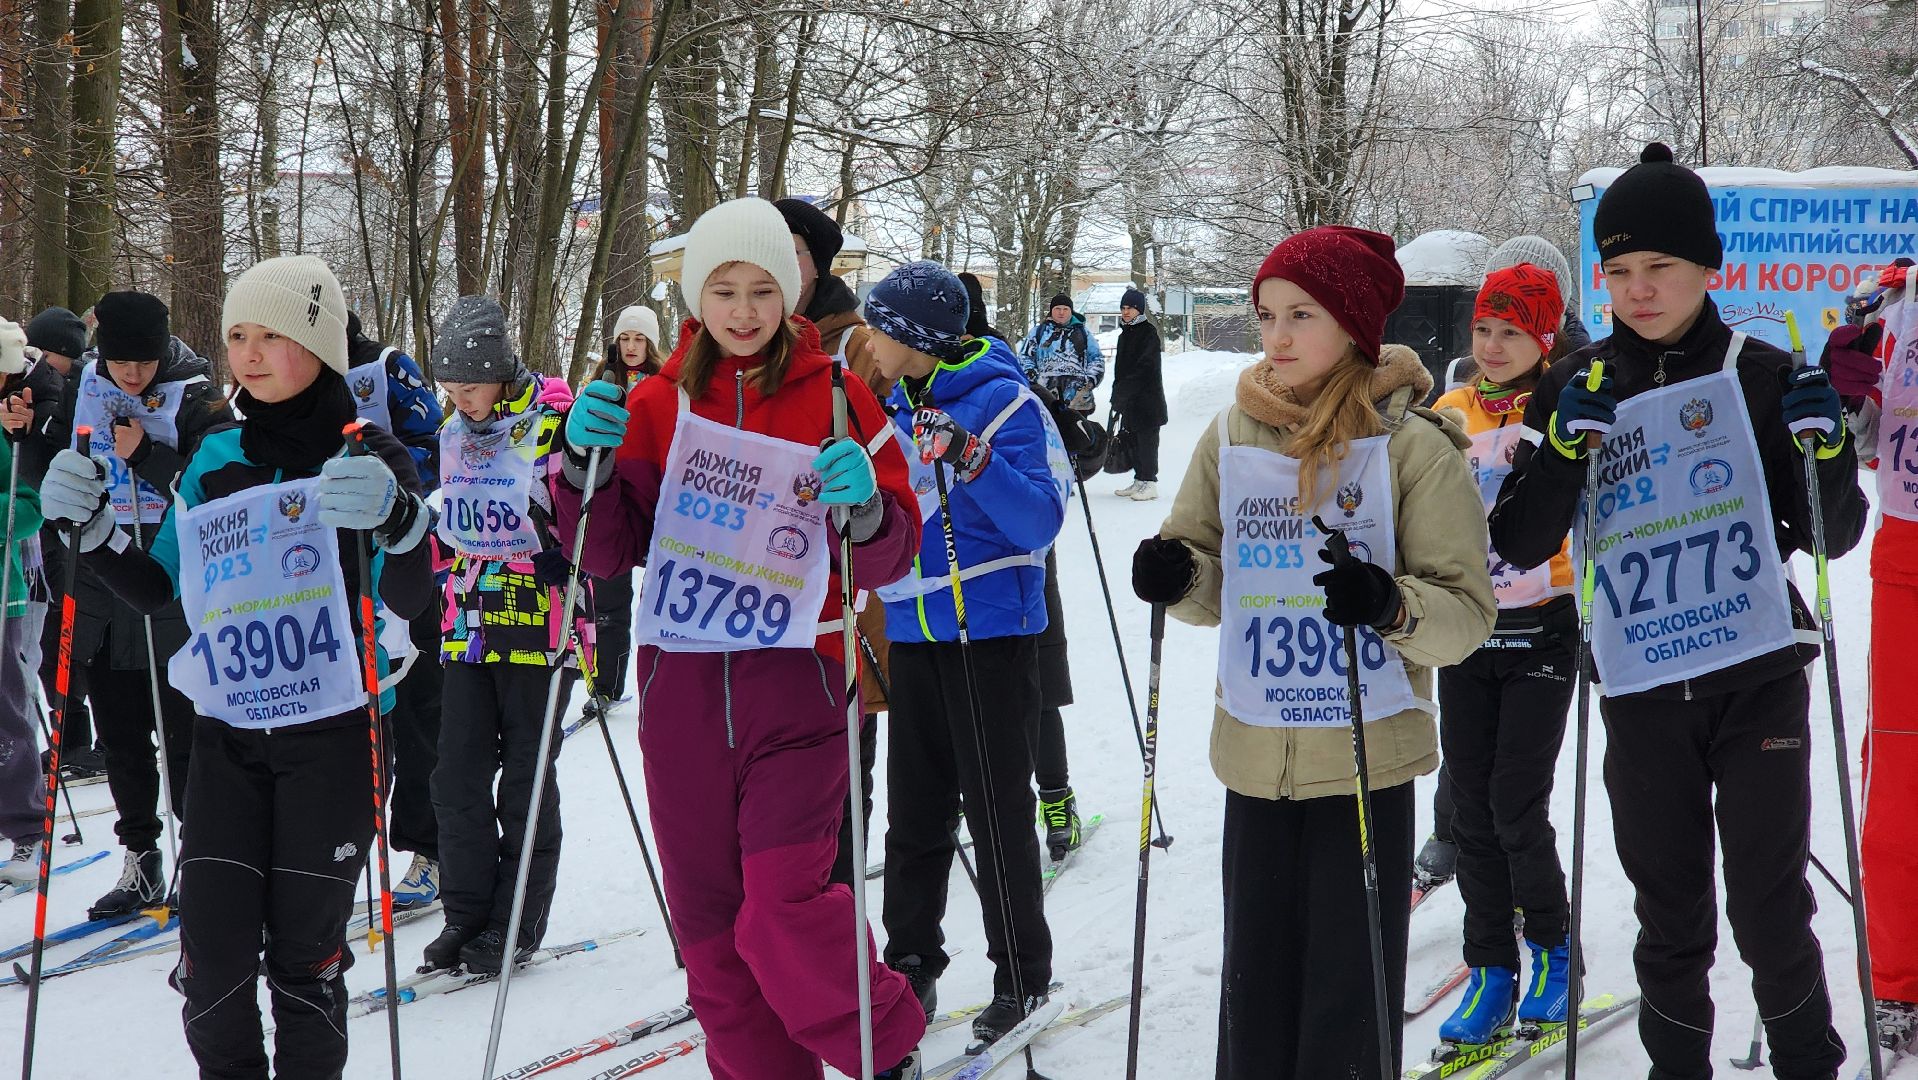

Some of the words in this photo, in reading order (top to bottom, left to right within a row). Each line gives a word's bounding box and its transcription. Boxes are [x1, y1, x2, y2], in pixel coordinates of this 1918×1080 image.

[1750, 197, 1871, 223] СПРИНТ
[1741, 329, 1769, 337] OTEL
[686, 448, 763, 485] ЛЫЖНЯ
[681, 468, 757, 506] РОССИИ
[199, 507, 248, 542] ЫЖНЯ
[443, 497, 521, 533] 10658
[674, 491, 748, 531] 2023
[1236, 496, 1304, 517] ЛЫЖНЯ
[1634, 517, 1688, 540] НОРМА
[1691, 496, 1745, 523] ЖИЗНИ
[1236, 518, 1303, 540] РОССИИ
[659, 536, 698, 559] СПОРТ
[704, 551, 754, 576] НОРМА
[755, 565, 805, 590] ЖИЗНИ
[1238, 543, 1305, 569] 2023
[1594, 520, 1761, 619] 12773
[232, 596, 280, 615] НОРМА
[280, 584, 333, 605] ЖИЗНИ
[653, 559, 792, 646] 13789
[1240, 594, 1277, 609] СПОРТ
[1286, 594, 1328, 609] НОРМ
[1624, 592, 1752, 645] МОСКОВСКАЯ
[190, 606, 341, 686] 13904
[1245, 616, 1387, 678] 13988
[1645, 625, 1738, 664] ОБЛАСТЬ
[226, 676, 321, 708] МОСКОВСКАЯ
[1265, 683, 1368, 703] МОСКОВСКЯ
[245, 702, 308, 721] ОБЛАСТЬ
[1280, 706, 1353, 722] ОБЛАСТЬ
[1530, 1018, 1588, 1057] BRADS
